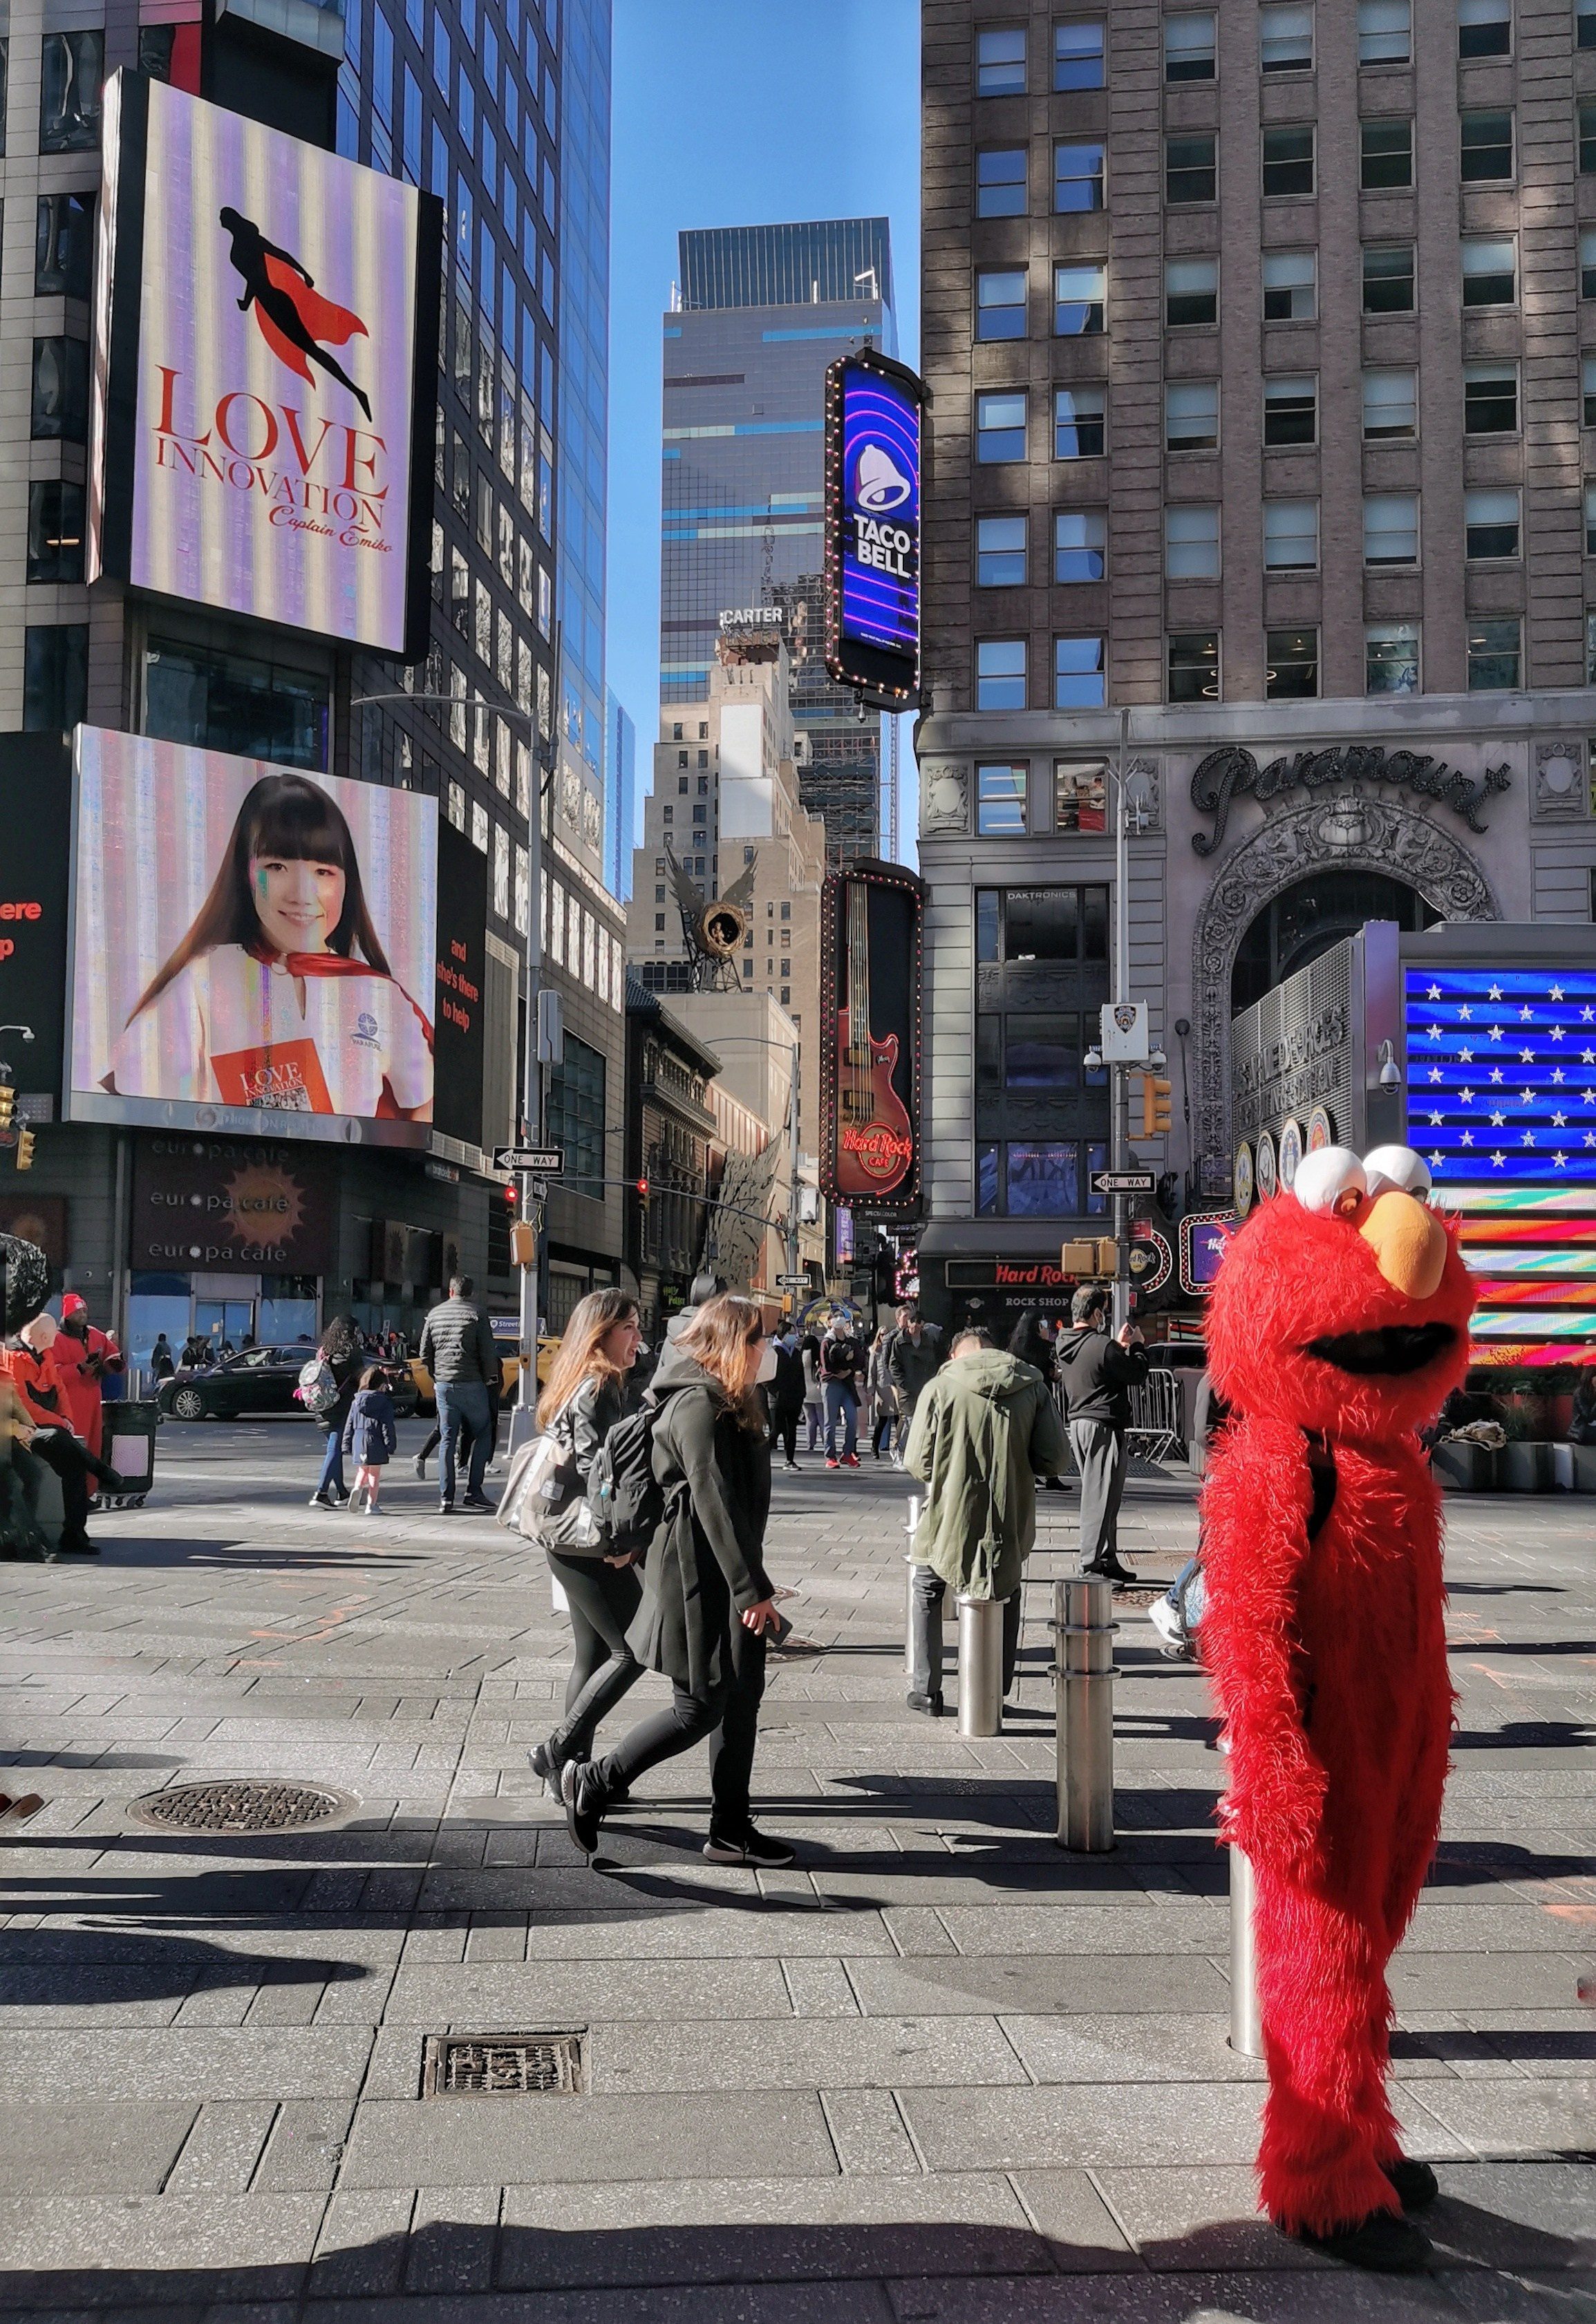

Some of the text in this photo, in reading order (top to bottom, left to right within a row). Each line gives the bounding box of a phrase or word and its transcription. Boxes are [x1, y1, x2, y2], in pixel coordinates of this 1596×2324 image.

[152, 364, 388, 500] LOVE
[156, 436, 385, 529] INNOVATION
[269, 505, 336, 537] Captain
[853, 513, 911, 554] TACO
[857, 539, 912, 578] BELL
[724, 607, 782, 623] CARTER
[1190, 746, 1512, 857] Paramount
[1007, 891, 1076, 900] DAKTRONICS
[451, 939, 467, 963] and
[437, 960, 478, 1003] she's there
[443, 996, 470, 1034] to help
[239, 1061, 302, 1090] LOVE
[245, 1078, 303, 1099] INNOVATION
[843, 1128, 913, 1160] Hard Rock
[504, 1155, 554, 1165] ONE WAY
[868, 1156, 890, 1169] CAFE
[1100, 1178, 1147, 1187] ONE WAY
[1207, 1238, 1227, 1250] Har
[1137, 1252, 1156, 1264] Rock
[995, 1265, 1039, 1283] Hard
[1006, 1298, 1069, 1306] ROCK SHOP
